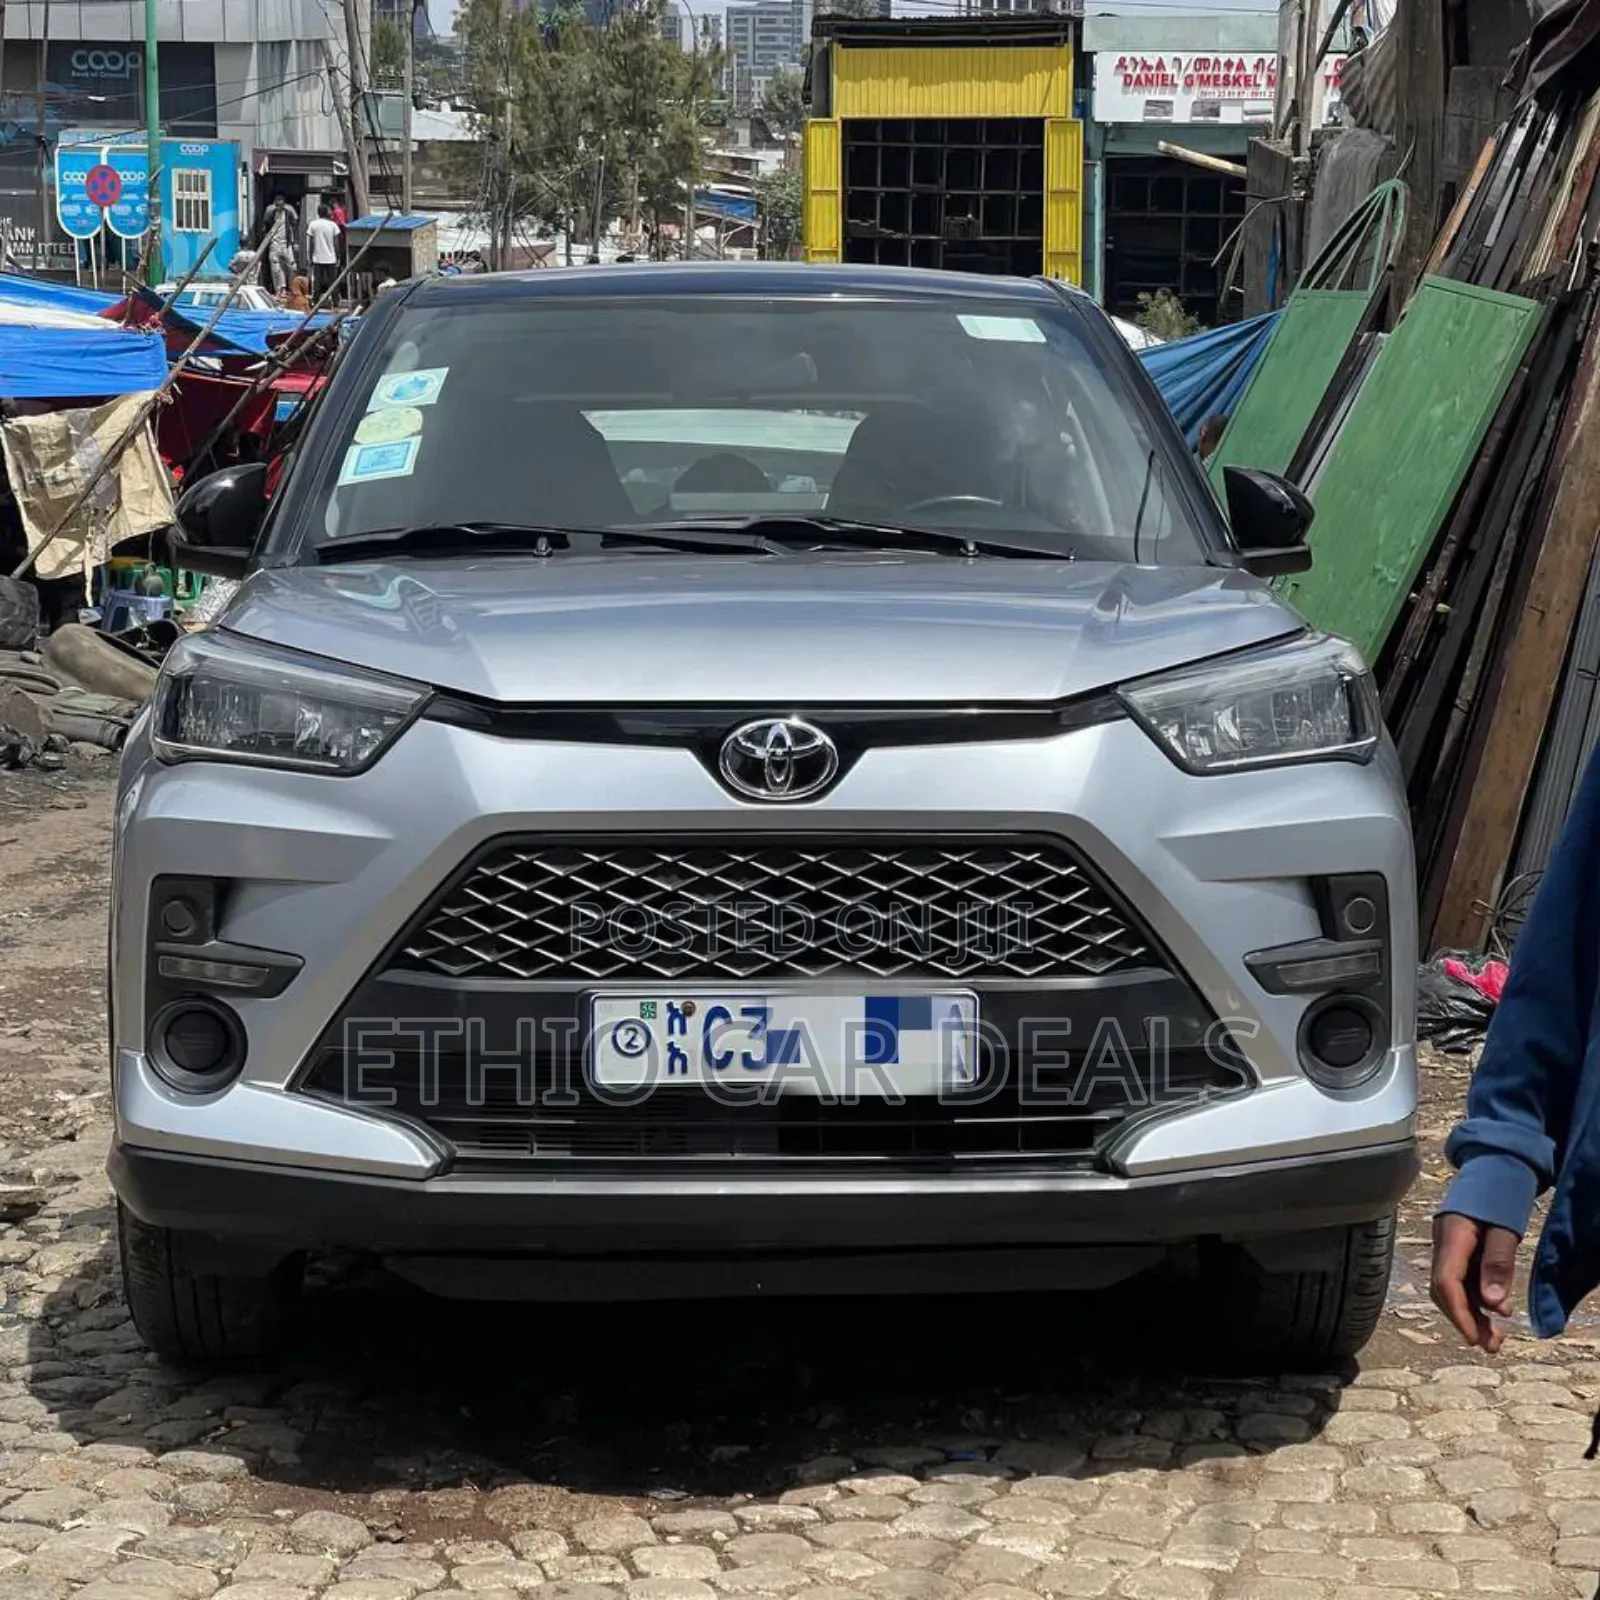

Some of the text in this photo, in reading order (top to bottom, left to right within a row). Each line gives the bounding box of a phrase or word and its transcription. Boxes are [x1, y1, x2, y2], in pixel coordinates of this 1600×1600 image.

[1123, 73, 1178, 88] DANIEL
[63, 171, 87, 182] coo
[117, 171, 146, 184] oop
